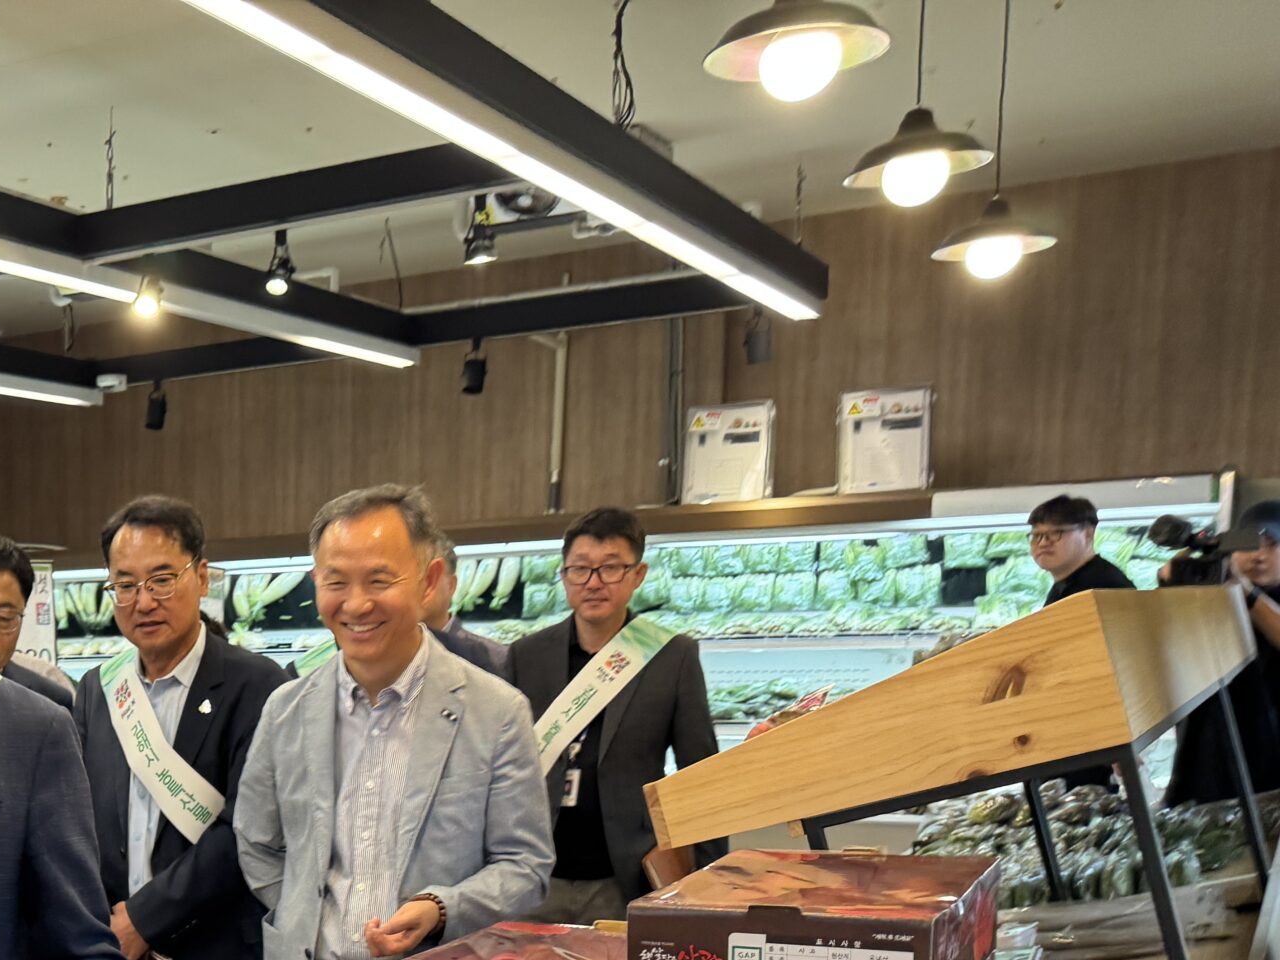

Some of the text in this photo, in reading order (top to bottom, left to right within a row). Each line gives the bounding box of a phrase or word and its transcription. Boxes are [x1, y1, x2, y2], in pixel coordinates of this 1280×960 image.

[131, 720, 213, 825] 김해시 농특산물
[738, 951, 756, 960] GAP
